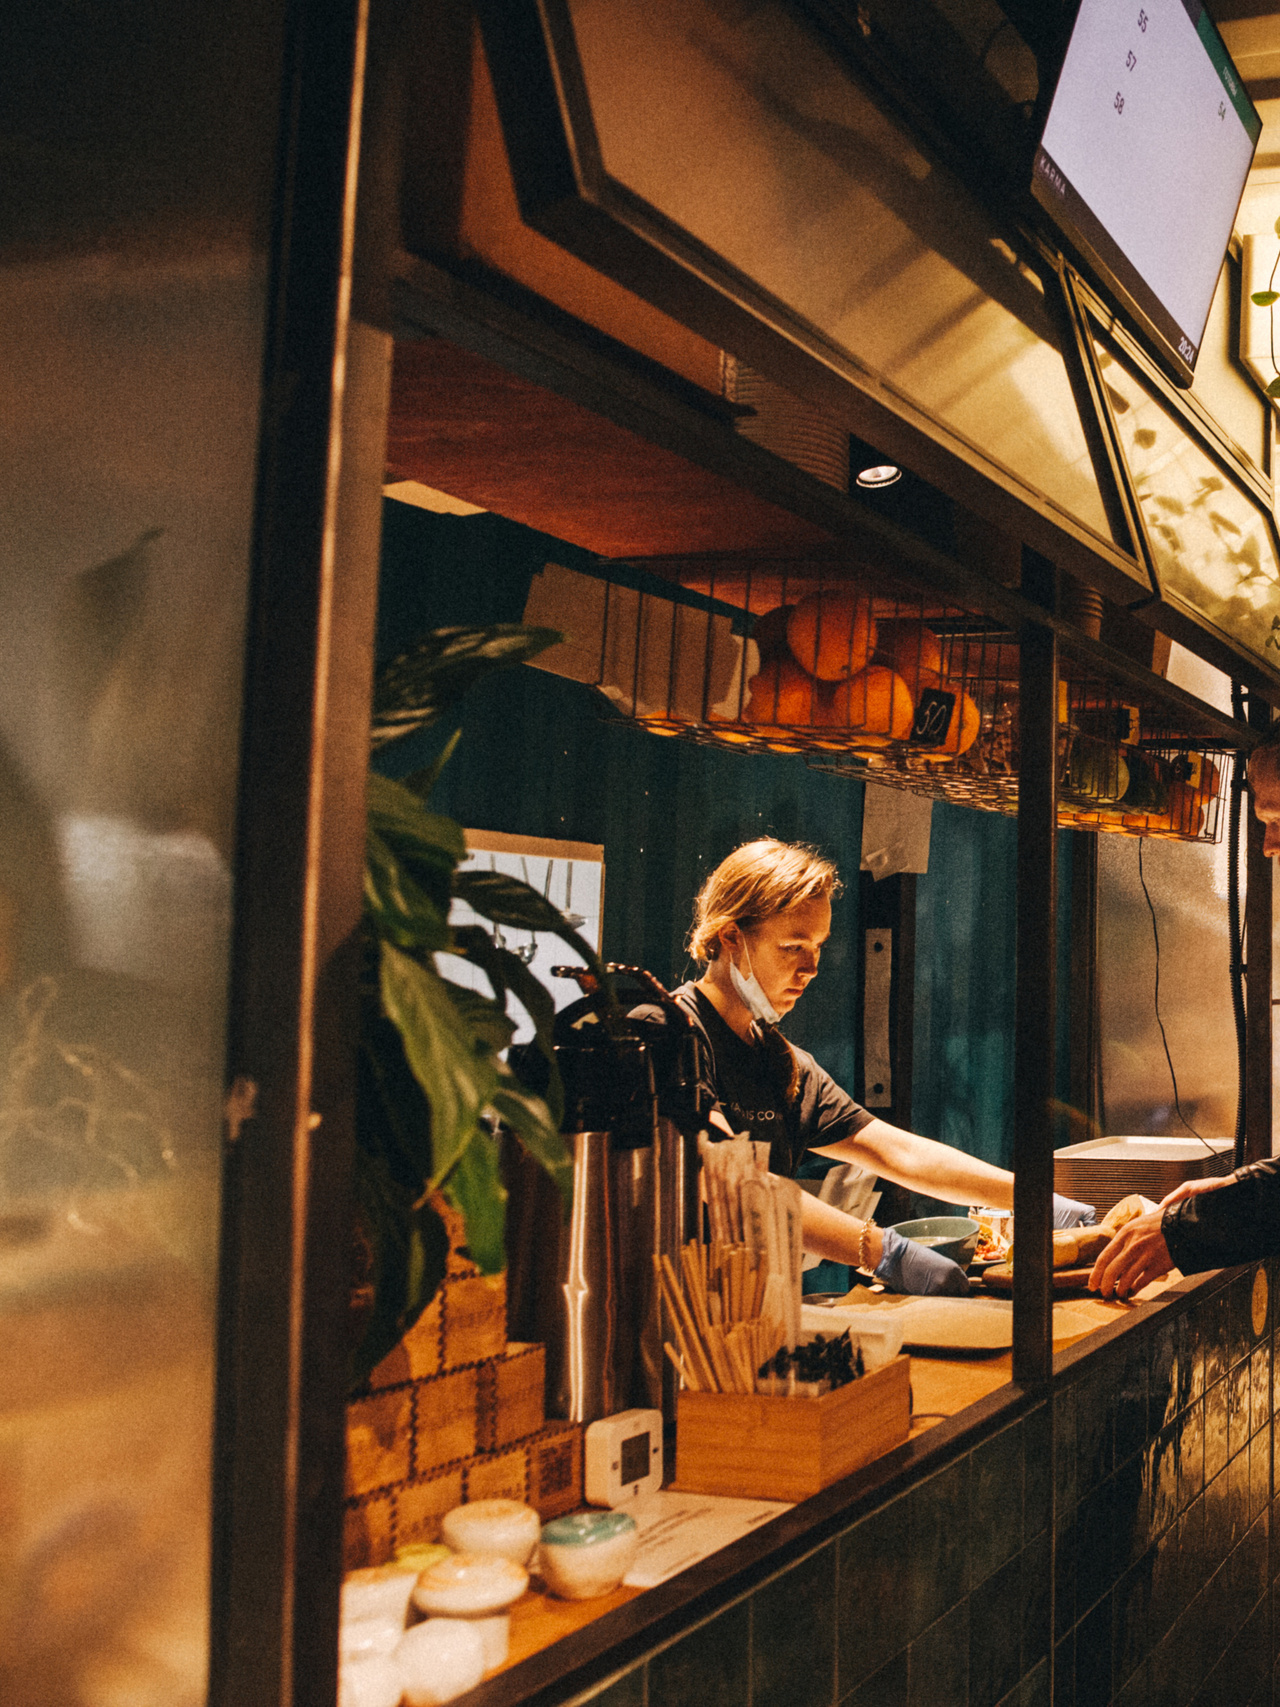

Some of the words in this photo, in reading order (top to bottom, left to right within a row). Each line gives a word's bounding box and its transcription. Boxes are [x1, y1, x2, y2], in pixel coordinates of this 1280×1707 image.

[1138, 8, 1149, 34] 55
[1126, 50, 1137, 72] 57
[1114, 91, 1125, 115] 58
[1218, 100, 1227, 121] 54
[1040, 155, 1066, 196] KARMA
